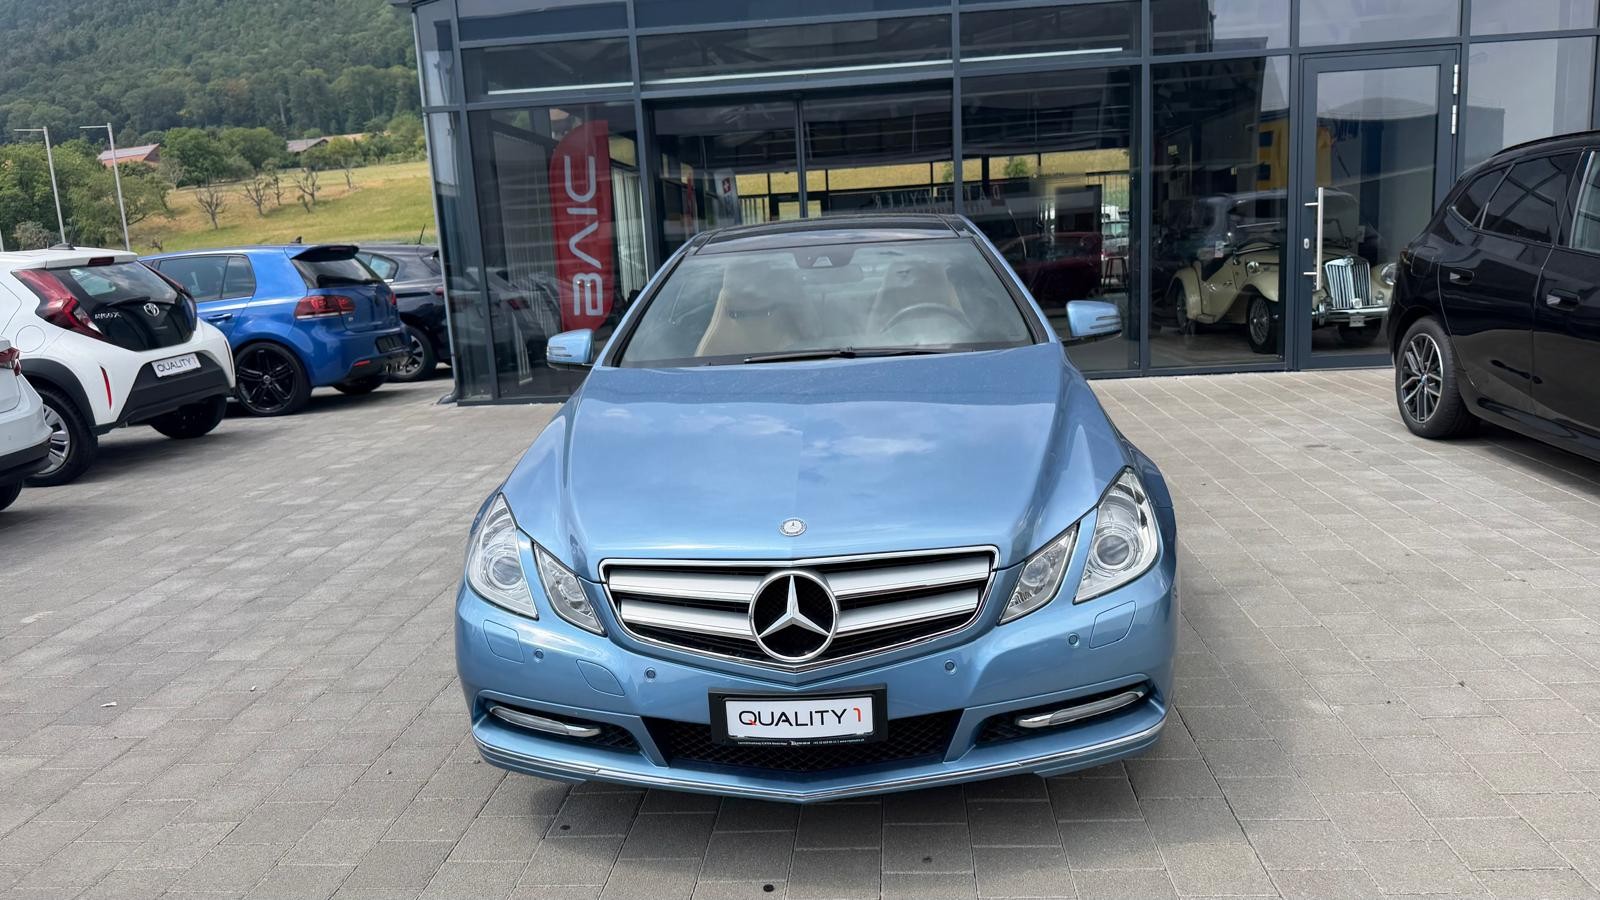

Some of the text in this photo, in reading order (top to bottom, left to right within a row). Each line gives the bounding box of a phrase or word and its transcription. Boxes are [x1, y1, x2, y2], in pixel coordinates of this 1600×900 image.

[564, 155, 604, 317] BAIC
[156, 358, 192, 372] QUALITY
[739, 707, 862, 726] QUALITY 1
